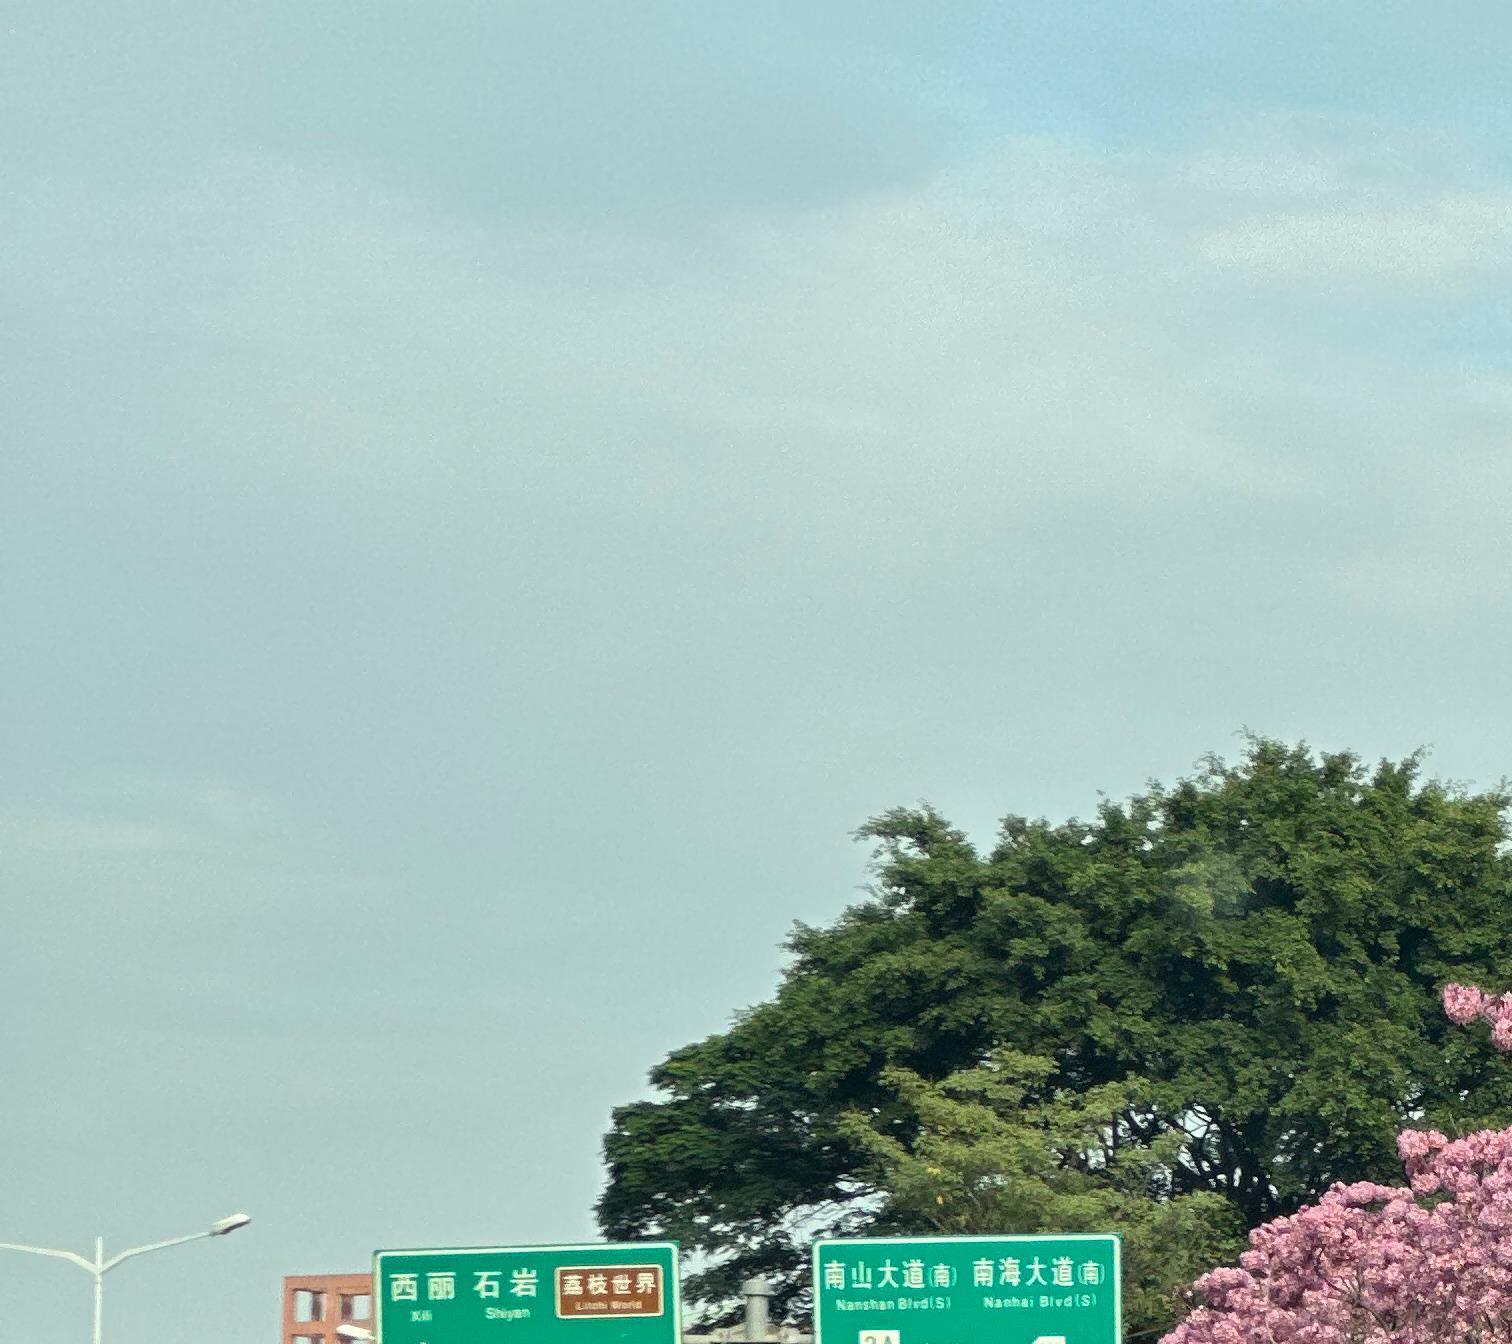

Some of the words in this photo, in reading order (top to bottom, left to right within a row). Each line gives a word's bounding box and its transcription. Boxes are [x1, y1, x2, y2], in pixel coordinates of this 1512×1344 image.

[388, 1270, 457, 1302] 西丽
[472, 1267, 539, 1299] 石岩
[561, 1271, 657, 1297] 荔枝世界
[835, 1298, 895, 1312] Nanshan
